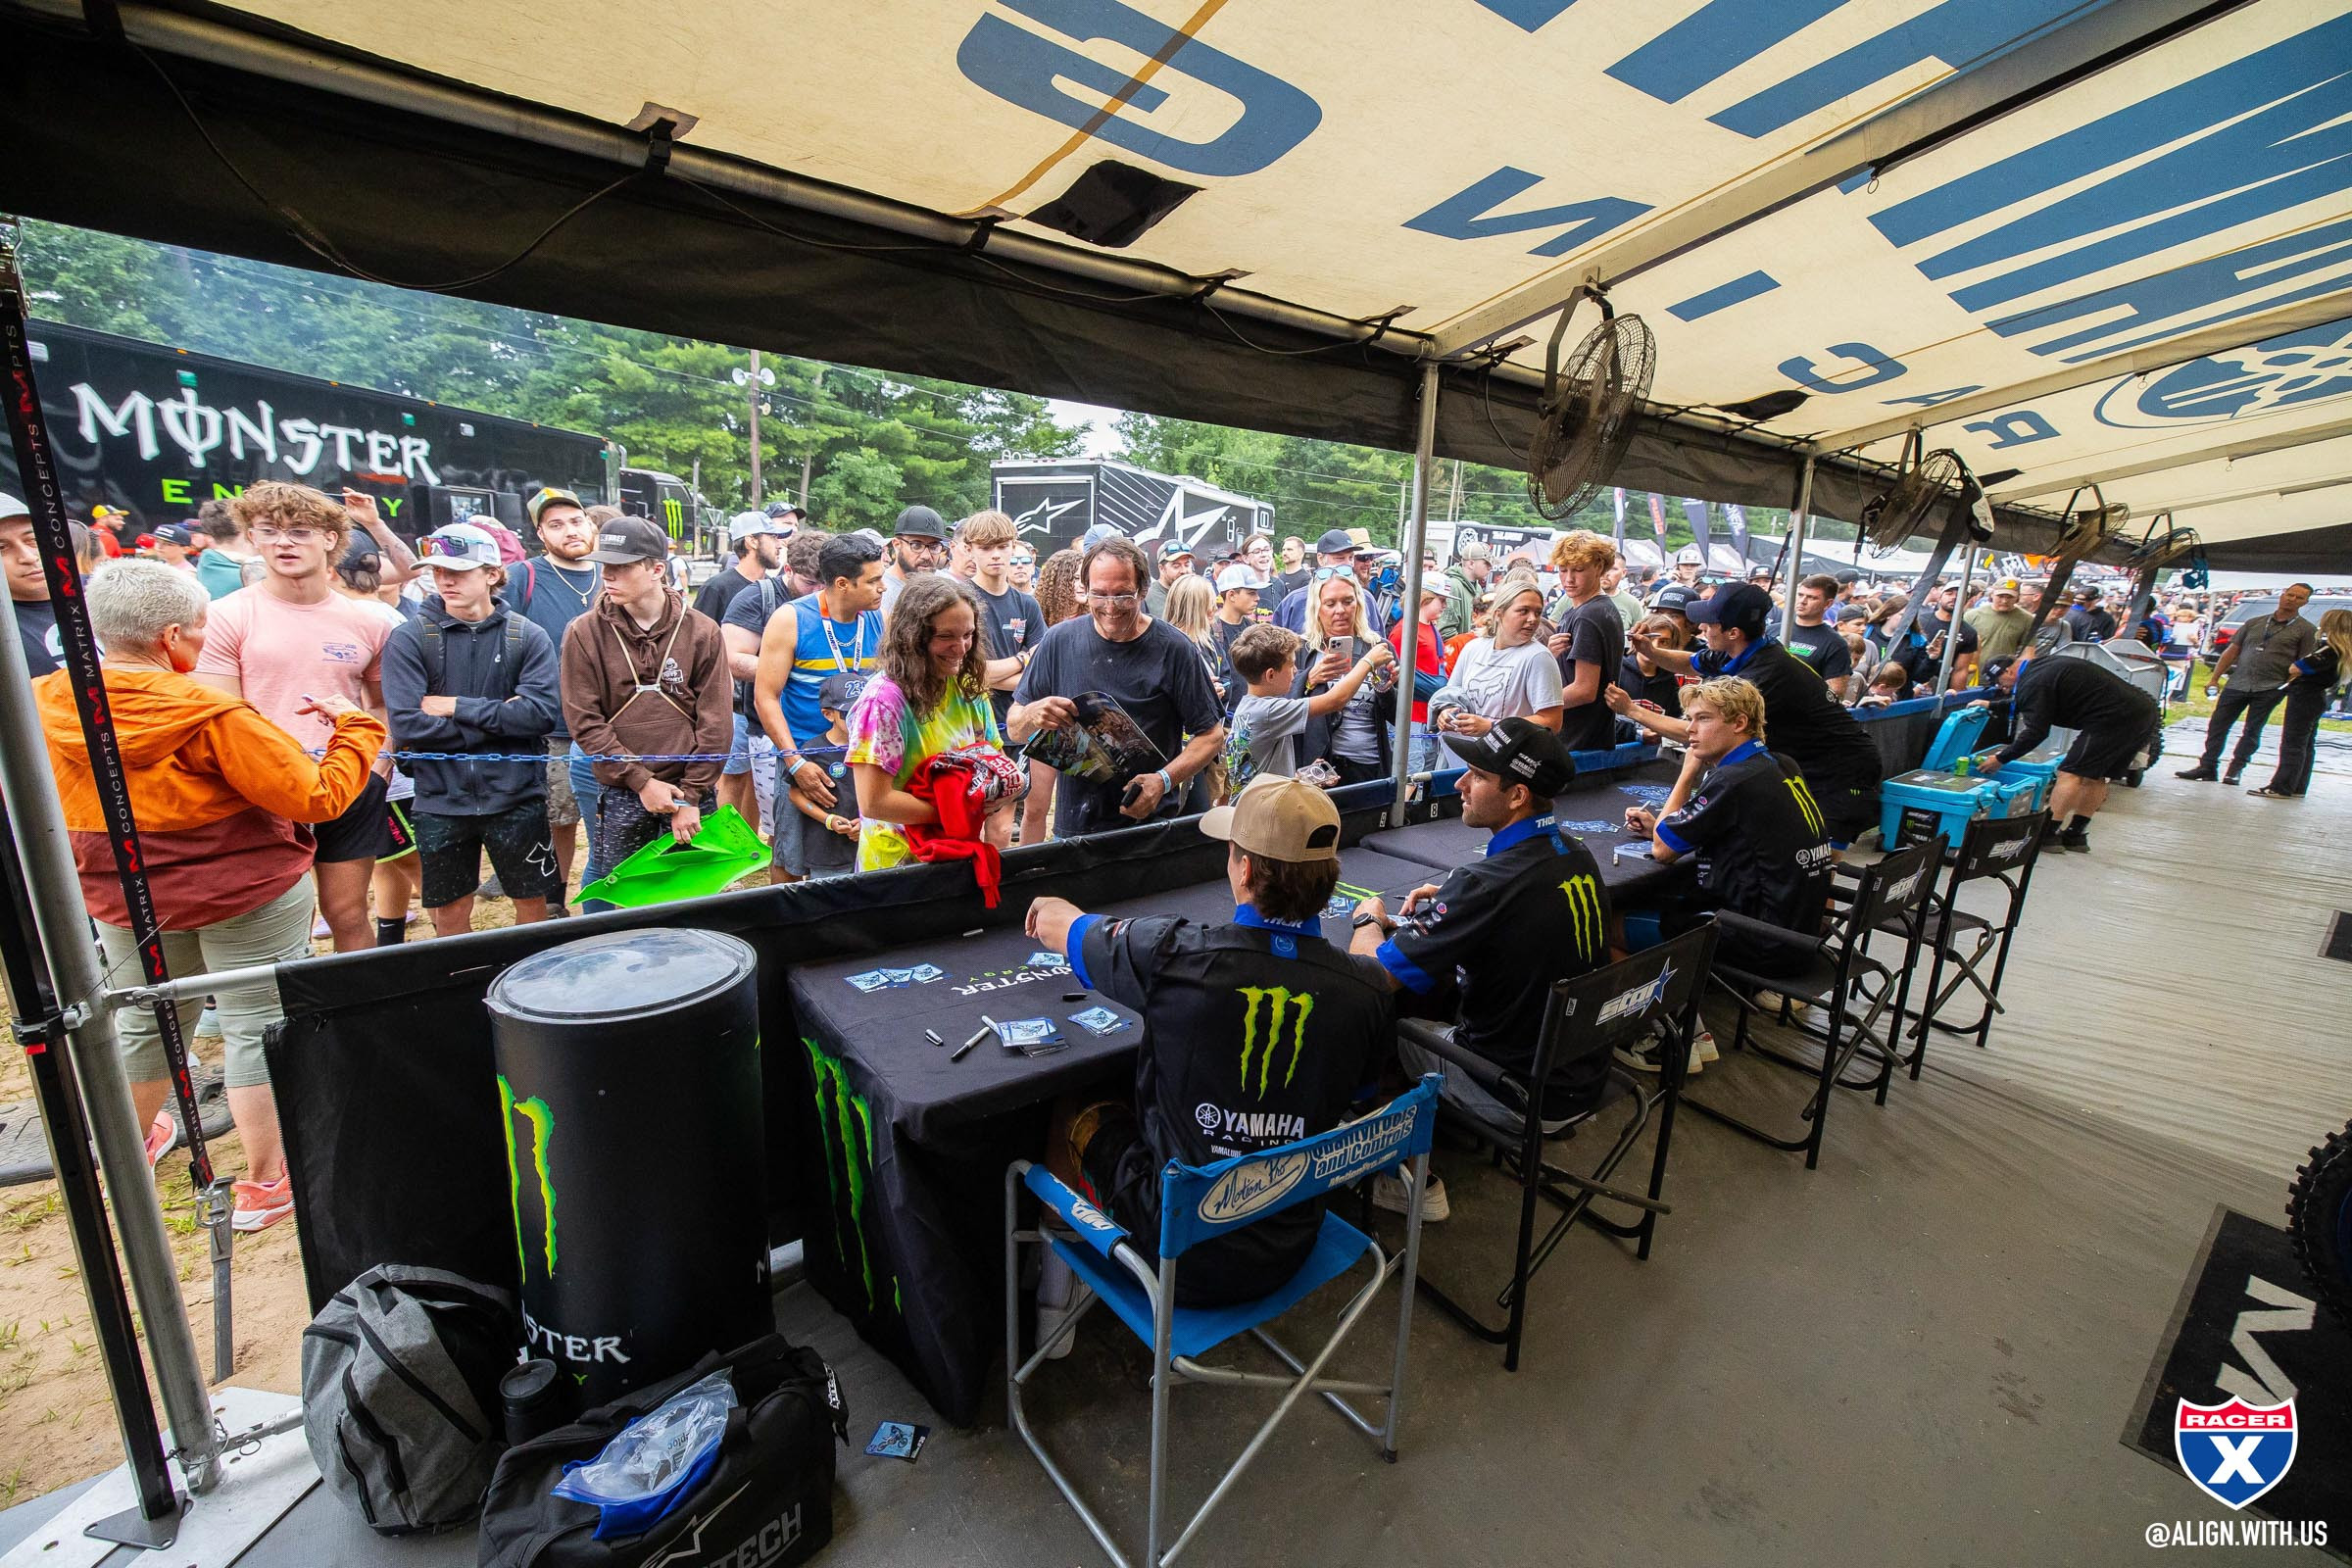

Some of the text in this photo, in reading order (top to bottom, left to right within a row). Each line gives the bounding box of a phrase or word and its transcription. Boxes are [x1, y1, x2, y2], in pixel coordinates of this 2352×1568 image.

[70, 382, 441, 486] MONSTER
[29, 423, 65, 549] CONCEPTS
[70, 606, 95, 677] MATRIX
[101, 732, 130, 833] CONCEPTS
[135, 878, 155, 937] MATRIX
[951, 964, 1073, 996] ONSTER
[165, 1000, 184, 1065] CONCEP
[1224, 1108, 1305, 1139] YAMAHA
[1314, 1120, 1414, 1179] and Controls
[1214, 1170, 1267, 1215] Motion
